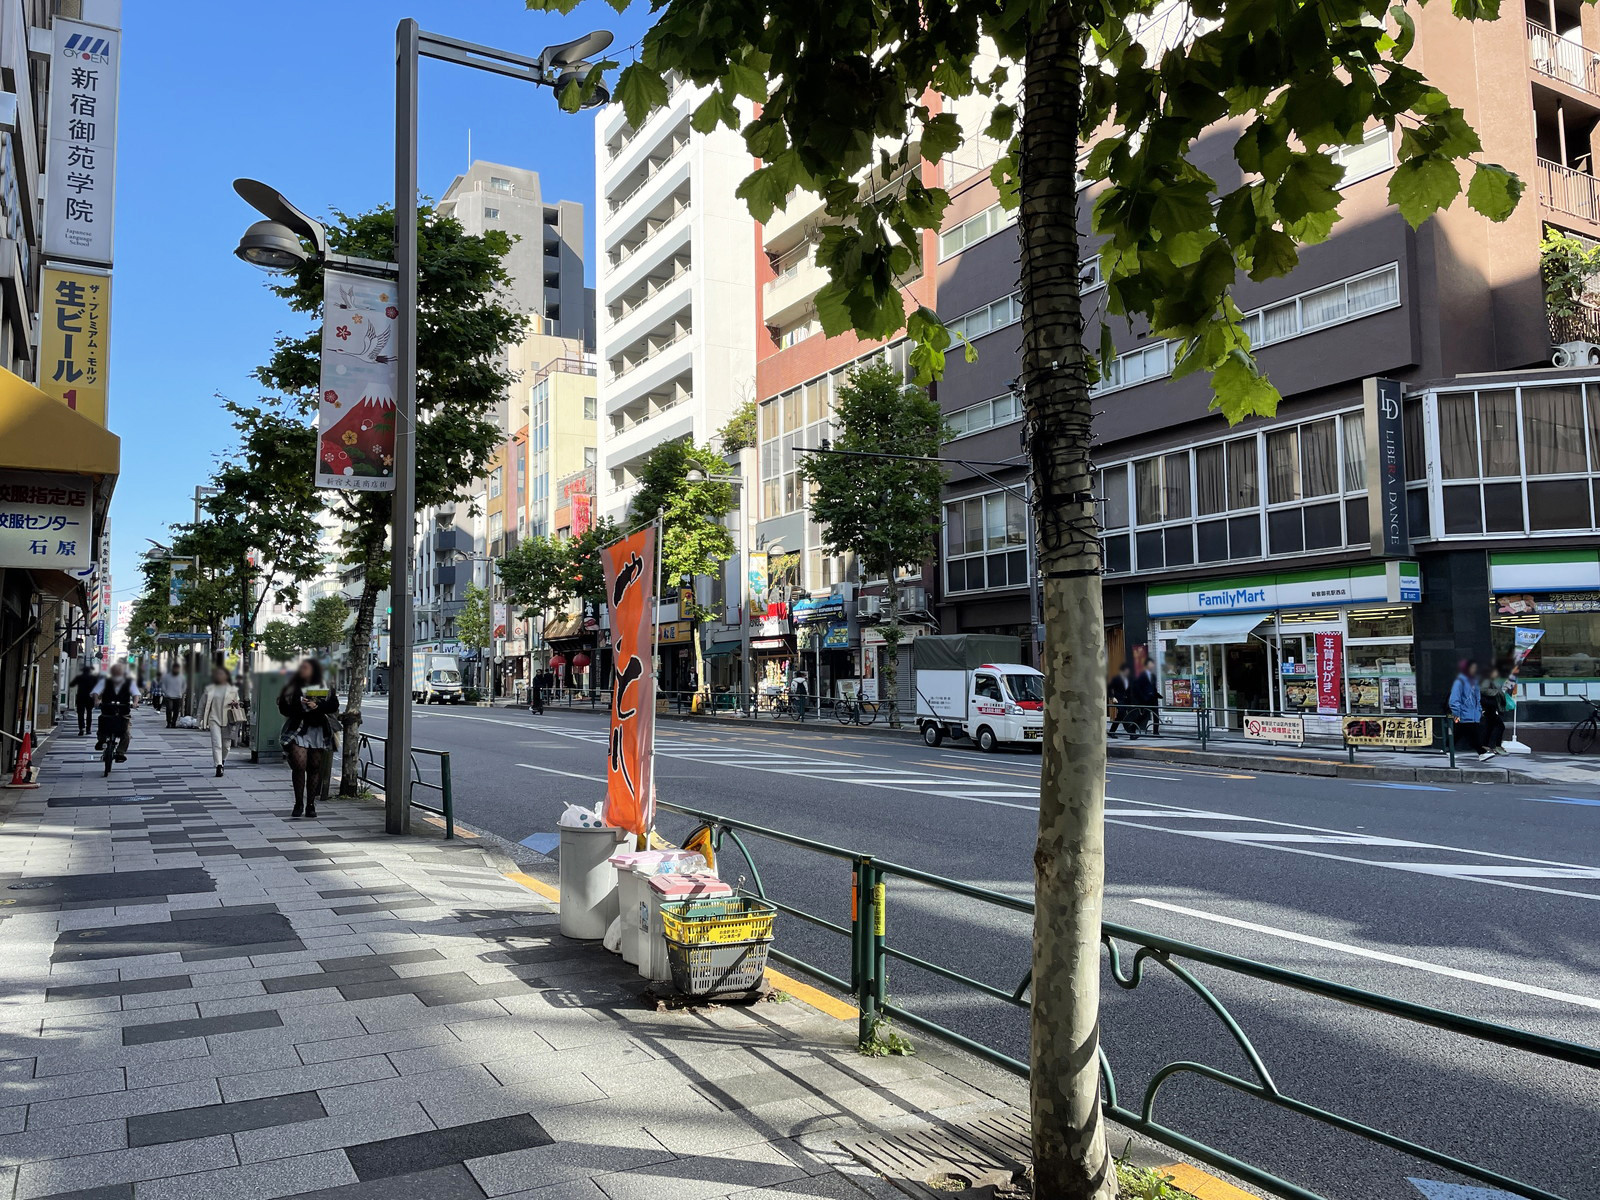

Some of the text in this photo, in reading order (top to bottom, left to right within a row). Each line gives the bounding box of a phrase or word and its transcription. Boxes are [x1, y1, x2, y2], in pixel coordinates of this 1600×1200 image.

[66, 66, 99, 223] 新宿御苑学院
[65, 233, 92, 242] Language
[66, 227, 92, 236] Japanese
[69, 239, 90, 247] School
[52, 280, 86, 383] 生ビール
[86, 284, 100, 385] ザ・プレミアム・モルツ
[1380, 388, 1399, 420] LD
[1386, 430, 1400, 545] LIBERA DANCE
[28, 539, 77, 556] 石原
[1198, 588, 1265, 607] FamilyMart
[611, 551, 644, 801] やとり
[1322, 637, 1335, 693] 年賀はがき
